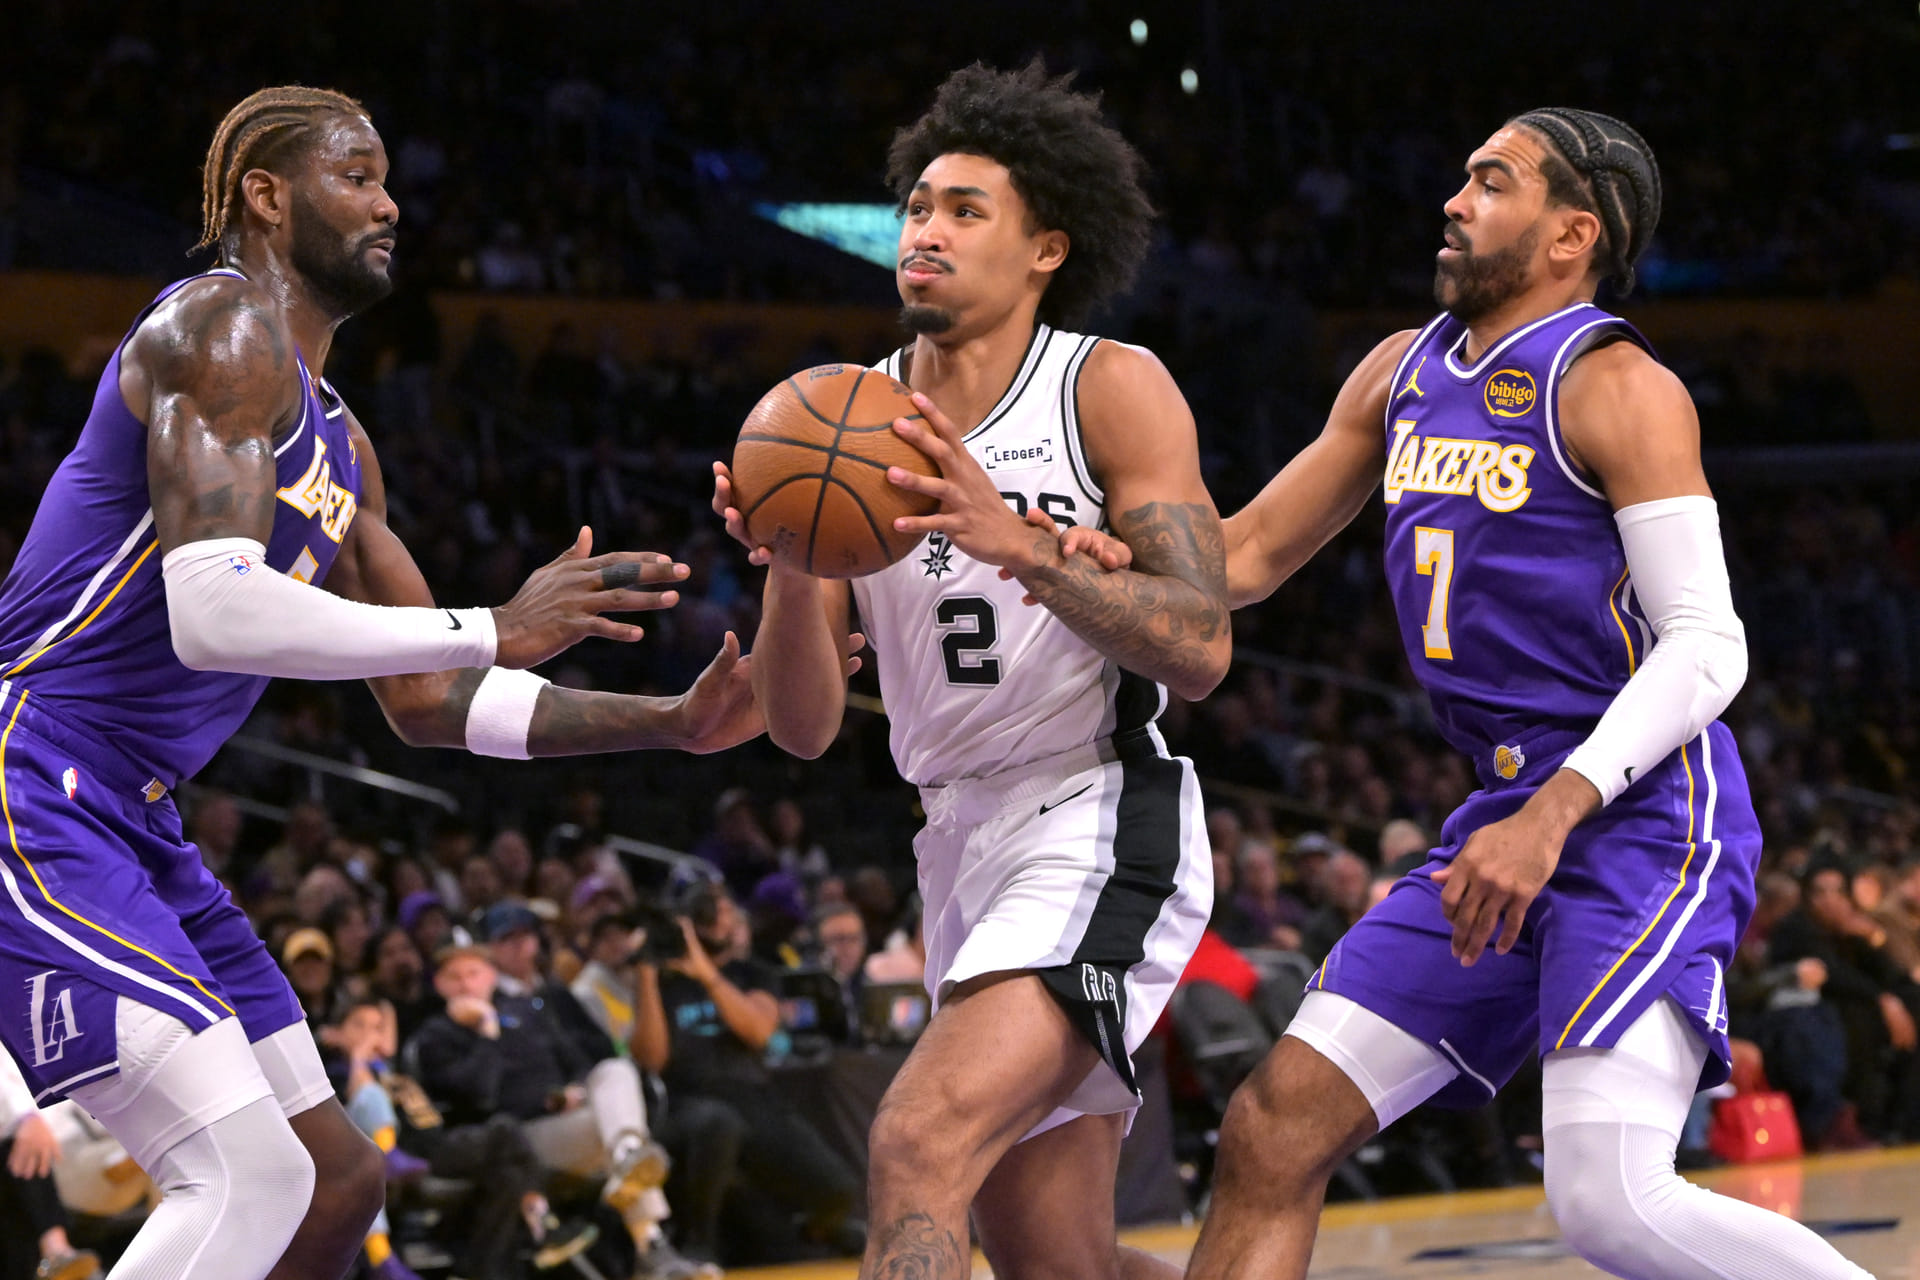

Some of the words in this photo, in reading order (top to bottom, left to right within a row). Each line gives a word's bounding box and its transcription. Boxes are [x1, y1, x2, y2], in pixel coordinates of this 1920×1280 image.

[1489, 381, 1533, 405] bibigo
[994, 446, 1044, 462] LEDGER
[1384, 420, 1536, 512] LAKERS
[1415, 525, 1454, 660] 7
[933, 595, 1003, 687] 2
[22, 970, 85, 1067] LA
